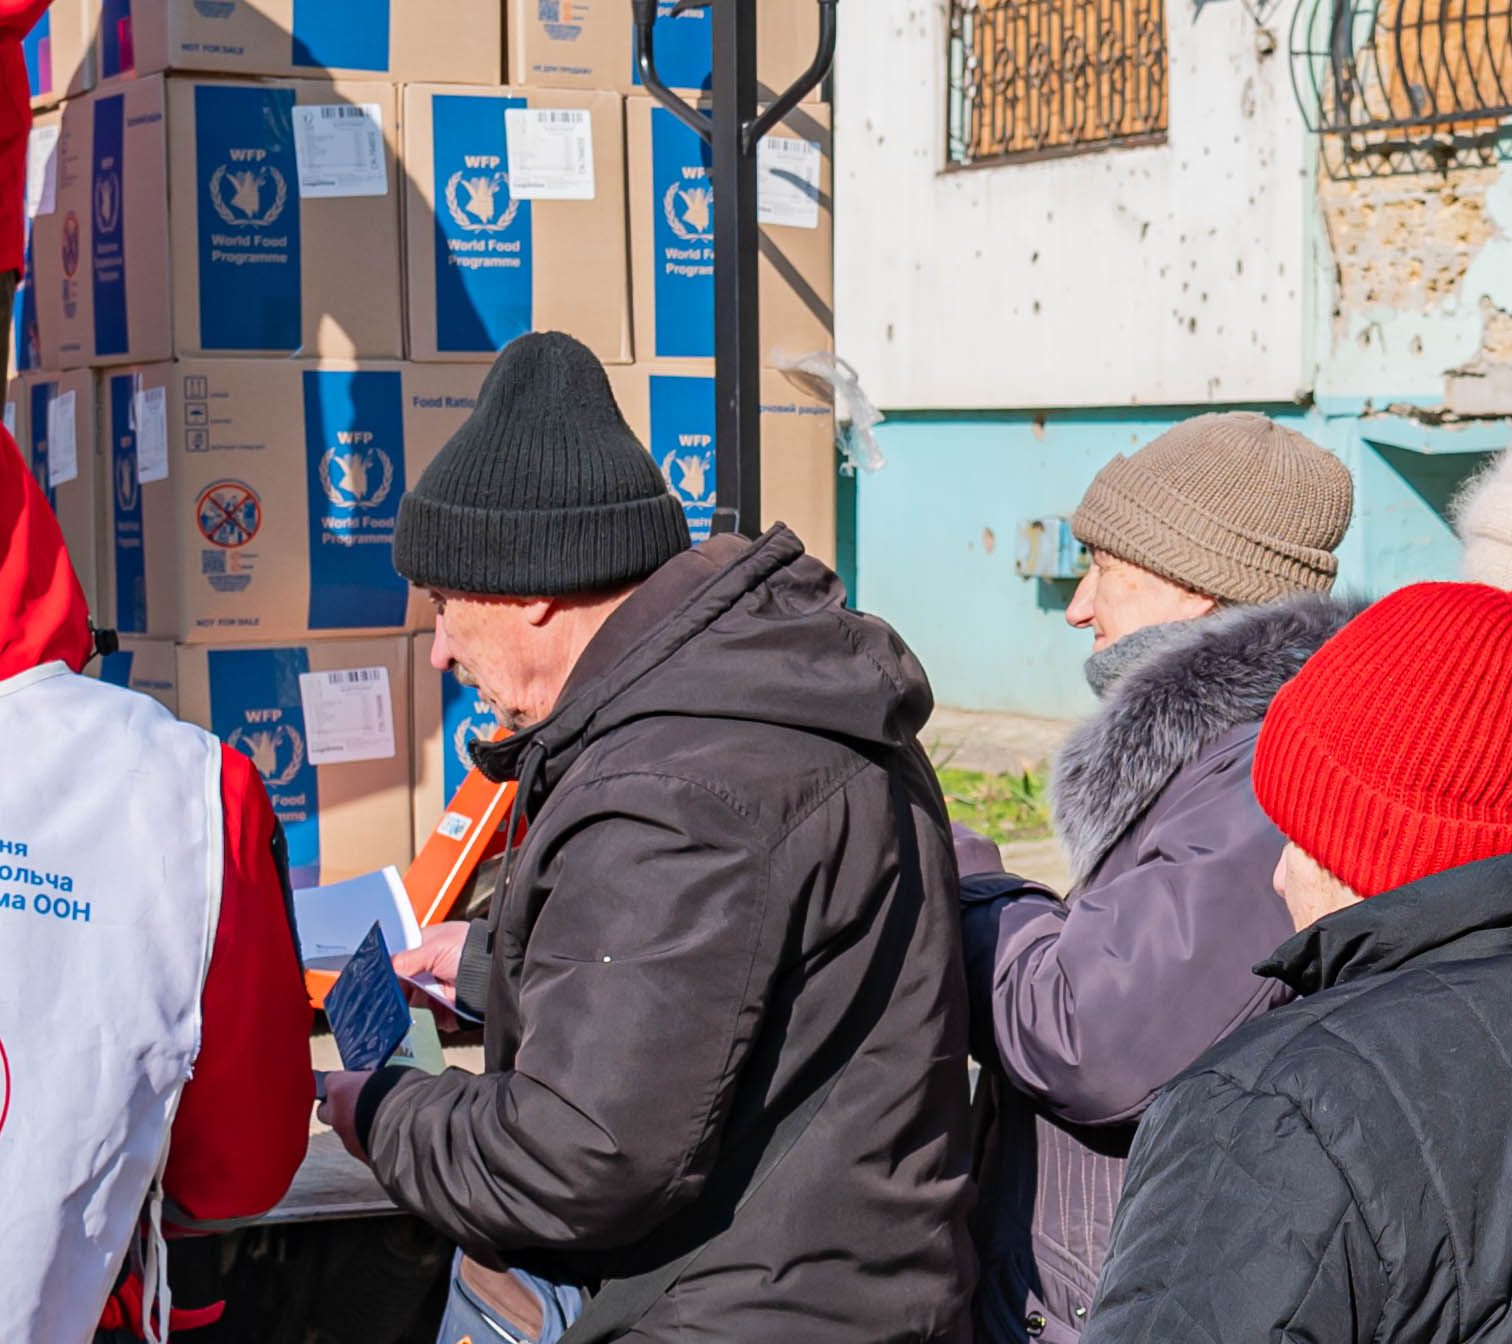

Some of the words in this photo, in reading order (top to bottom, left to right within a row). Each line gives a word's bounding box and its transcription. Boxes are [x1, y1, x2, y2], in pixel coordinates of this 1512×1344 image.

[230, 149, 266, 162] WFP
[464, 155, 500, 169] WFP
[212, 234, 250, 247] World
[254, 235, 287, 248] Food
[448, 239, 485, 252] World
[489, 240, 520, 253] Food
[212, 250, 288, 266] Programme
[665, 247, 700, 260] World
[448, 255, 521, 270] Programme
[413, 396, 442, 409] Food
[445, 396, 476, 409] Ratio
[337, 431, 373, 446] WFP
[679, 434, 711, 447] WFP
[321, 515, 359, 529] World
[362, 515, 394, 529] Food
[196, 619, 215, 629] NOT
[218, 618, 236, 628] FOR
[238, 617, 260, 628] SALE
[246, 709, 282, 724] WFP
[272, 794, 306, 807] Food
[33, 893, 91, 922] ООН
